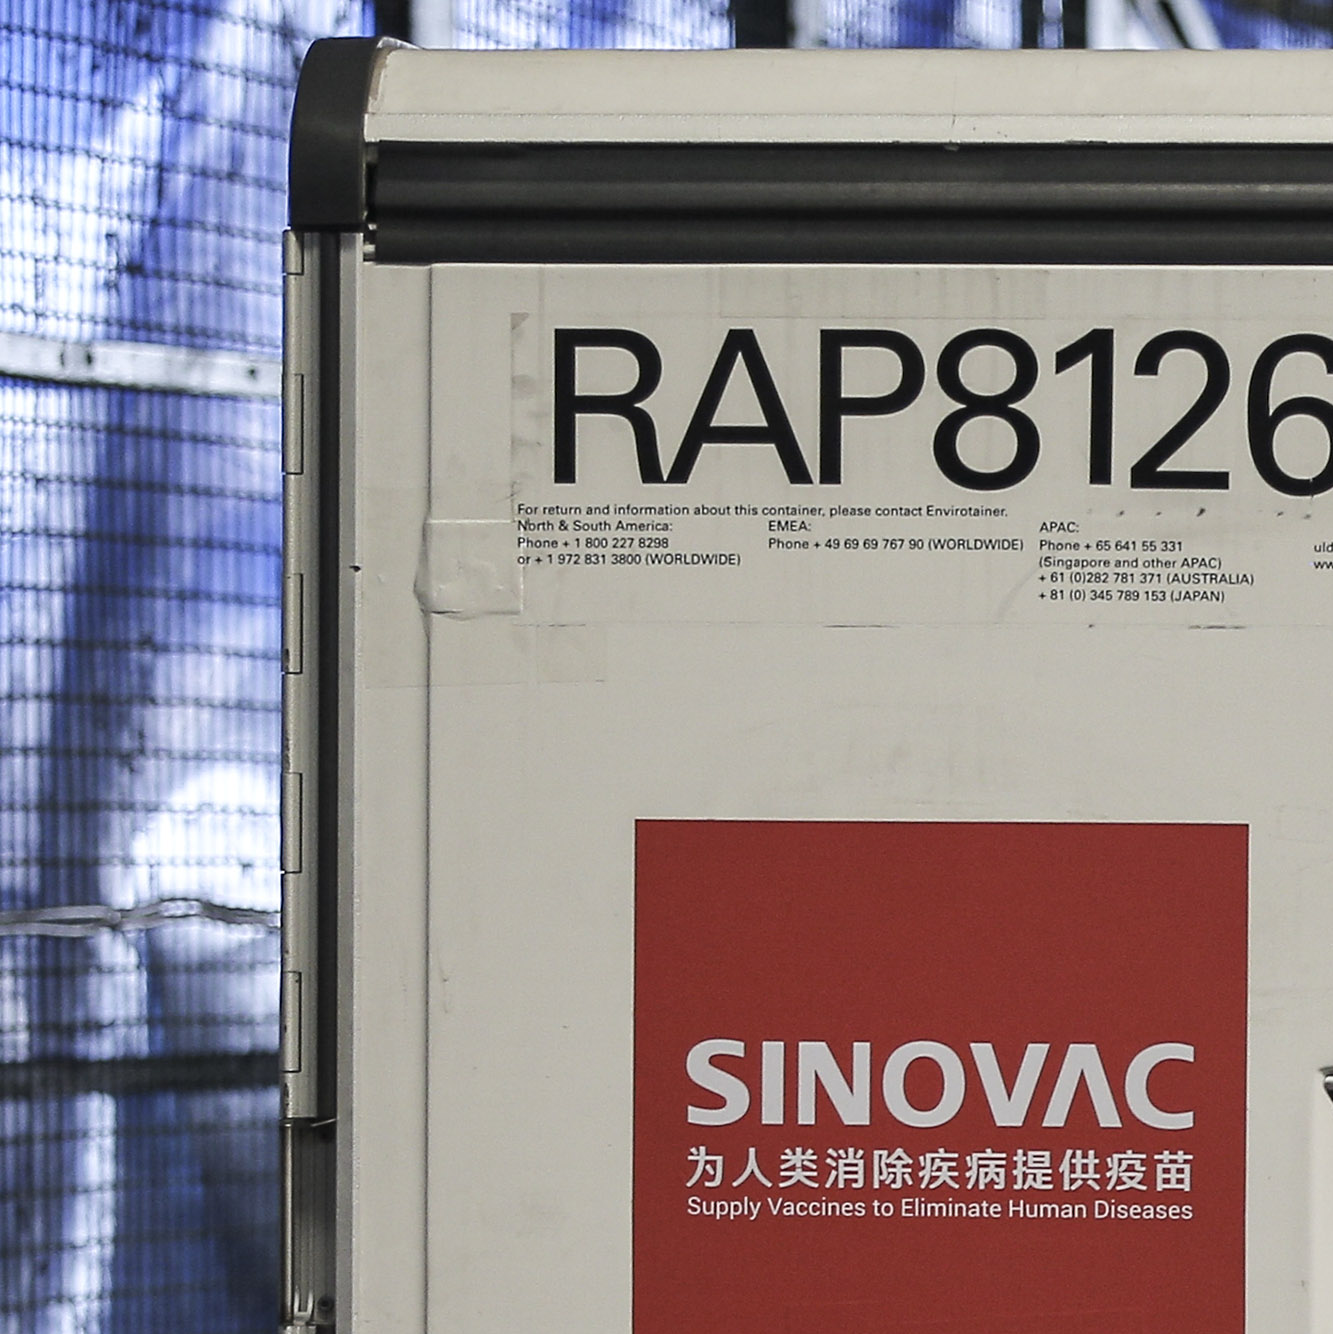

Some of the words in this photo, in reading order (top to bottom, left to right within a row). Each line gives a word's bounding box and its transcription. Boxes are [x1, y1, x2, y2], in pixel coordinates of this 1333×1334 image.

[517, 502, 539, 516] For
[542, 504, 582, 516] return
[585, 504, 610, 516] and
[613, 503, 690, 516] information
[693, 503, 731, 516] about
[734, 503, 759, 516] this
[761, 504, 826, 518] container,
[829, 504, 872, 519] please
[874, 506, 923, 517] contact
[926, 504, 1008, 517] Envirotainer.
[517, 518, 555, 532] North
[558, 519, 569, 532] &
[572, 519, 612, 532] South
[614, 519, 673, 532] America:
[768, 519, 812, 532] EMEA:
[1039, 520, 1080, 534] APAC:
[517, 536, 559, 549] Phone
[584, 536, 609, 549] 800
[611, 537, 635, 549] 227
[637, 536, 669, 549] 8298
[768, 537, 810, 550] Phone
[824, 537, 841, 550] 49
[843, 537, 860, 550] 69
[862, 538, 879, 550] 69
[882, 538, 905, 551] 767
[908, 538, 925, 551] 90
[927, 537, 1024, 552] (WORLDWIDE)
[1039, 539, 1081, 552] Phone
[1095, 539, 1112, 552] 65
[1114, 539, 1137, 552] 641
[1141, 540, 1158, 553] 55
[1160, 540, 1183, 553] 331
[516, 555, 532, 565] or
[557, 553, 581, 565] 972
[584, 553, 606, 566] 831
[610, 553, 642, 565] 3800
[644, 552, 741, 567] (WORLDWIDE)
[1038, 555, 1111, 571] (Singapore
[1113, 557, 1139, 569] and
[1142, 557, 1177, 569] other
[1180, 556, 1222, 570] APAC)
[1049, 571, 1065, 584] 61
[1112, 571, 1135, 584] 781
[1139, 572, 1162, 585] 371
[1166, 572, 1255, 587] (AUSTRALIA)
[1049, 588, 1065, 601] 81
[1069, 588, 1087, 602] (0)
[1089, 589, 1114, 602] 345
[1116, 589, 1140, 602] 789
[1143, 589, 1167, 602] 153
[1169, 589, 1225, 604] (JAPAN)
[686, 1039, 1195, 1129] SINOVAC
[686, 1146, 1193, 1192] 为人类消除疾病提供疫苗
[687, 1195, 762, 1221] Supply
[767, 1196, 866, 1217] Vaccines
[872, 1199, 894, 1217] to
[901, 1197, 1002, 1218] Eliminate
[1008, 1199, 1087, 1219] Human
[1094, 1199, 1193, 1220] Diseases
